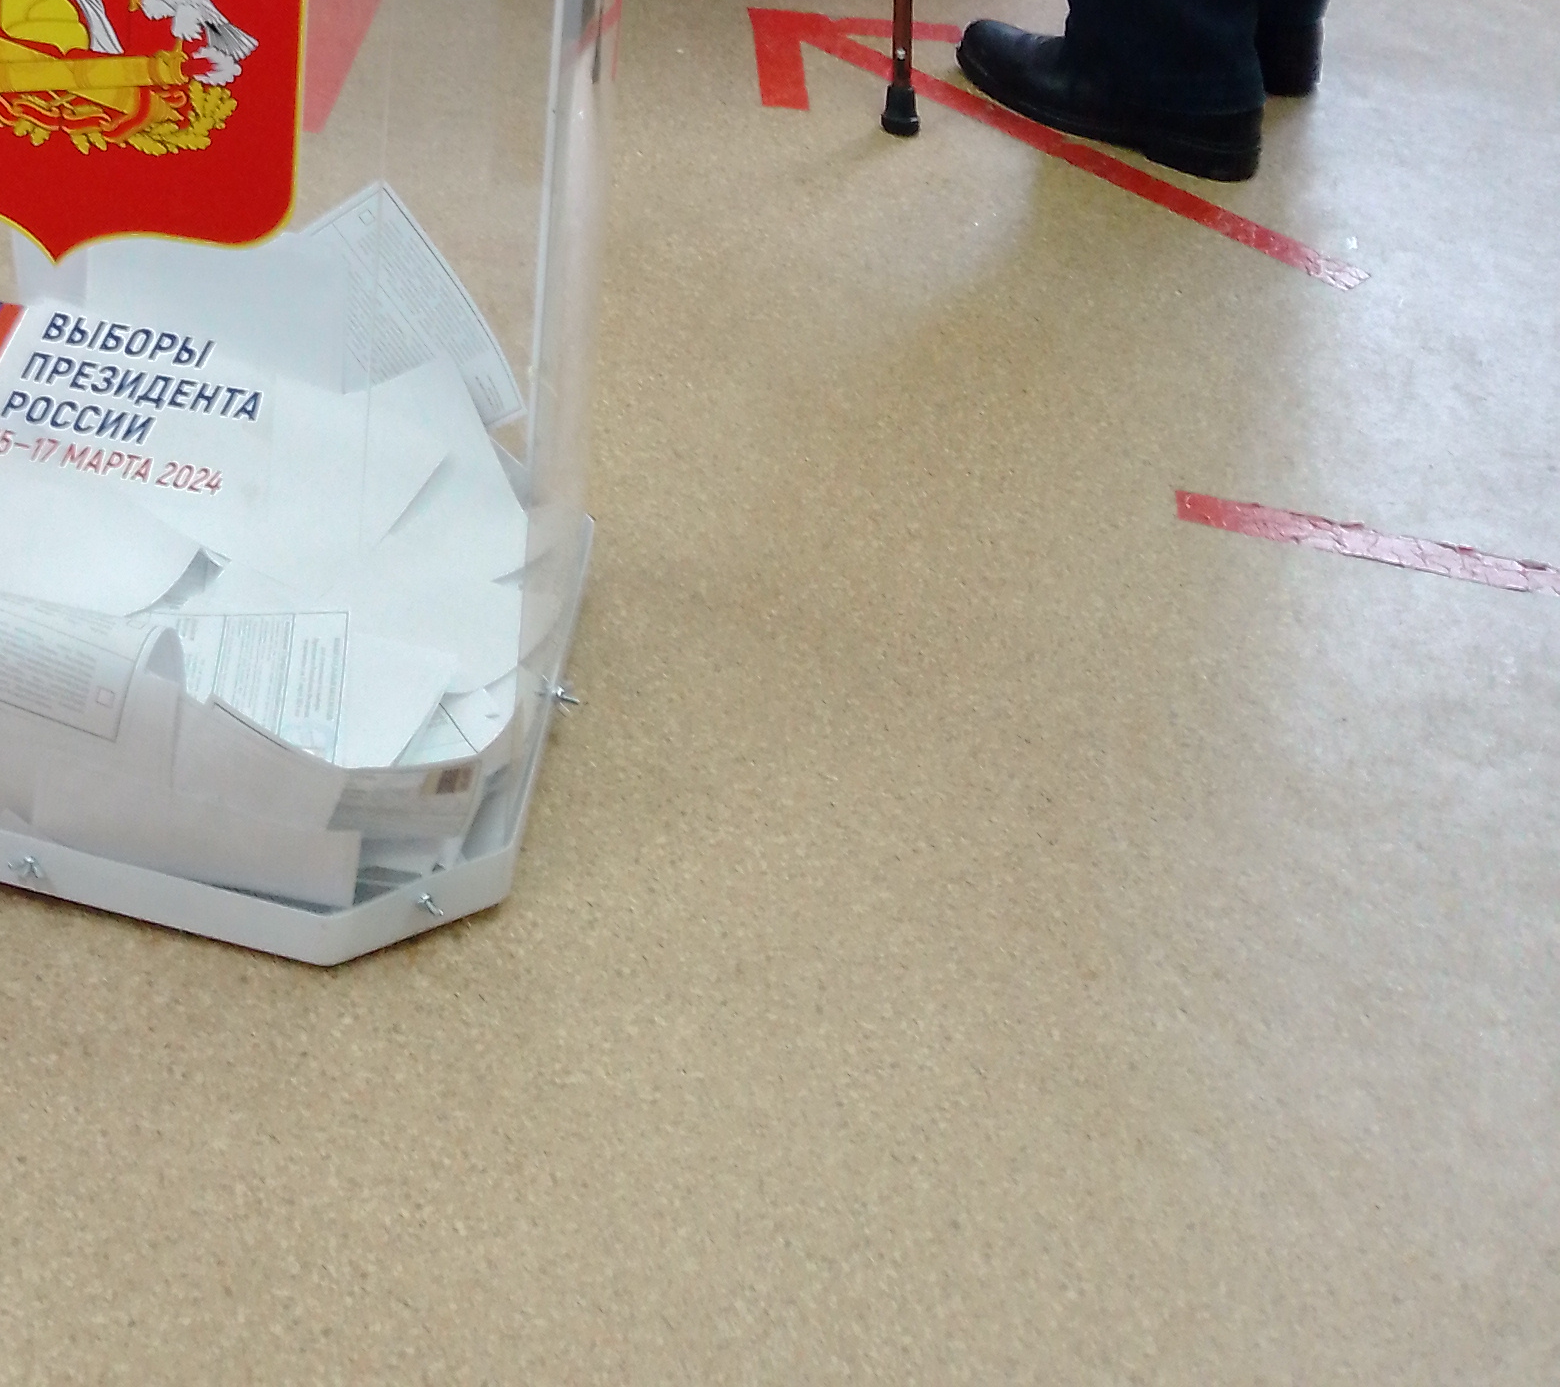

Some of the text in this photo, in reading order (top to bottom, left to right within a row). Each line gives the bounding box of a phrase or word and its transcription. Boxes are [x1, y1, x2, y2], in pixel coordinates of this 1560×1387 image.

[42, 311, 215, 369] ВЫБОРЫ
[20, 351, 263, 422] ПРЕЗИДЕНТА
[1, 390, 156, 445] РОССИИ
[60, 443, 153, 483] МАРТА
[155, 461, 223, 496] 2024
